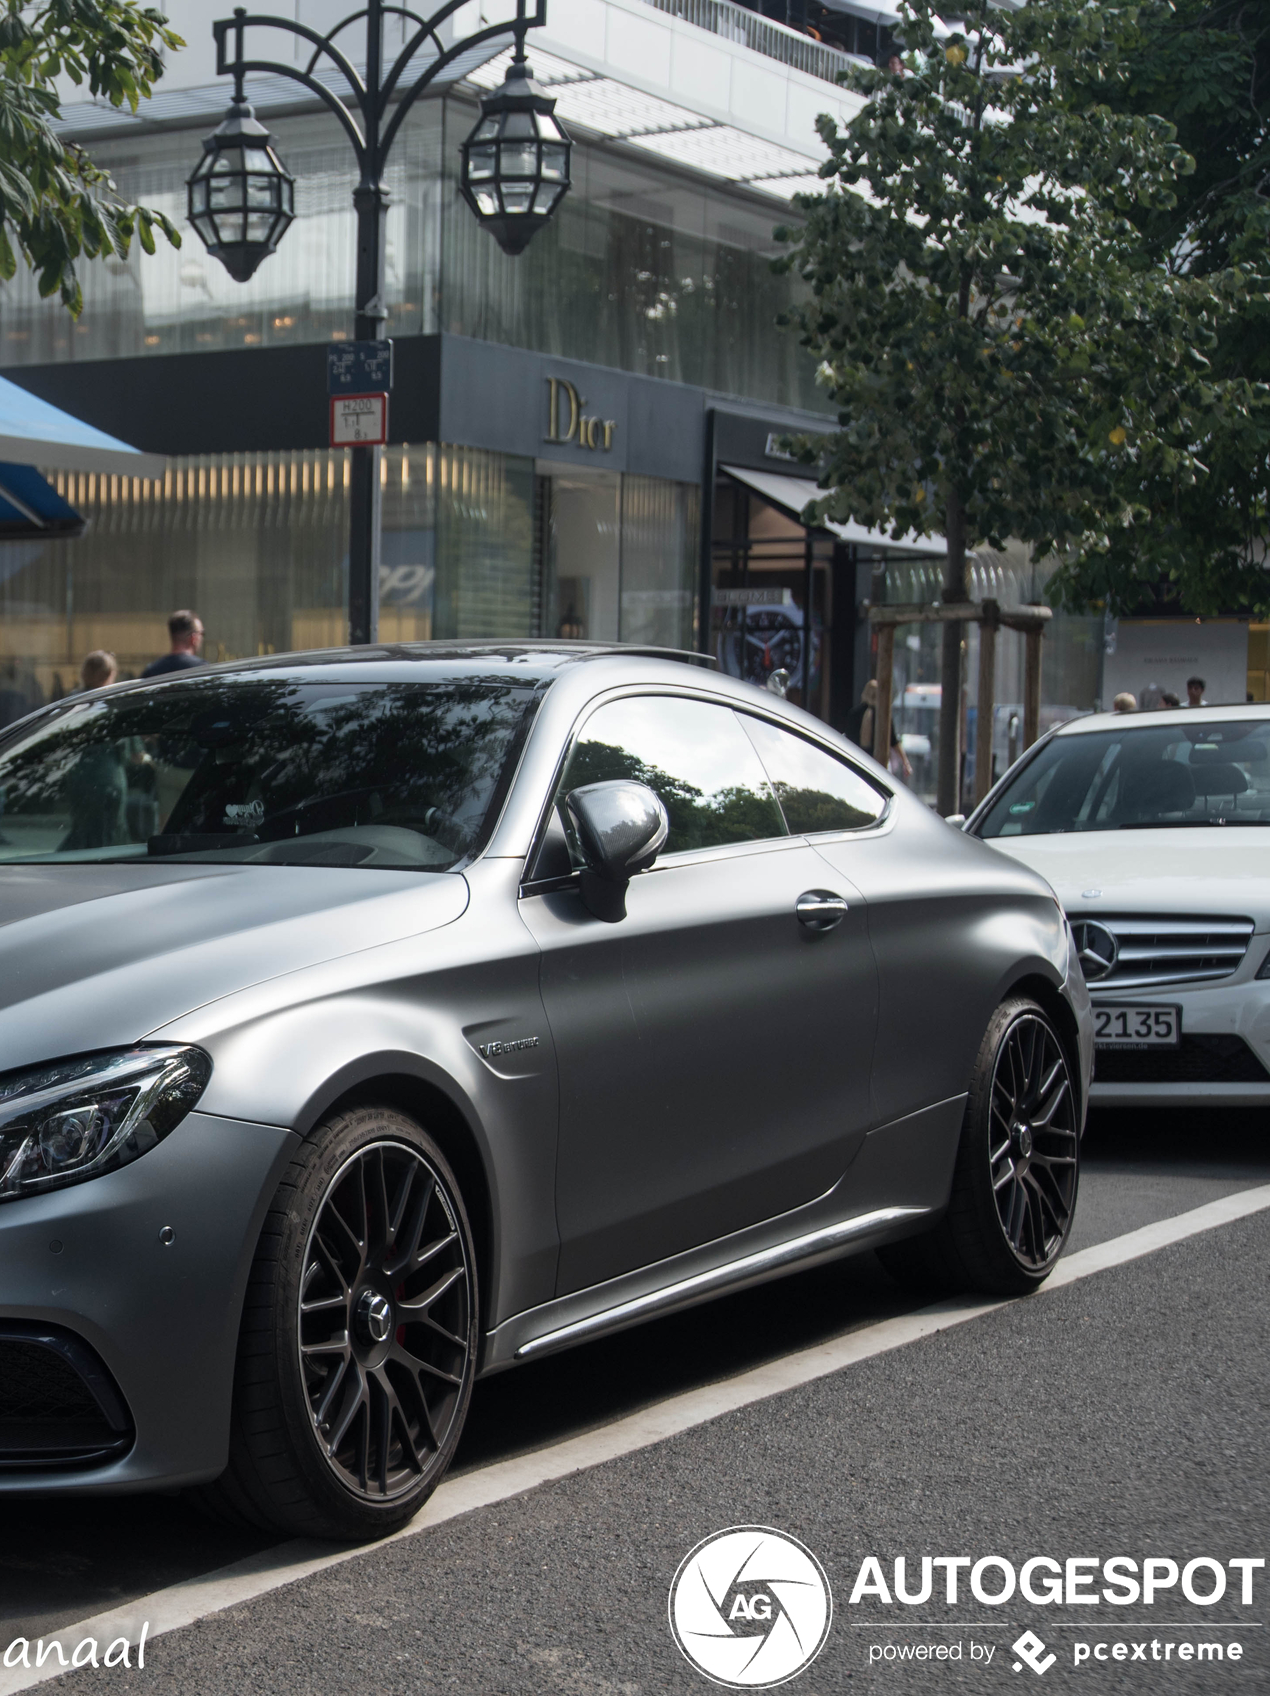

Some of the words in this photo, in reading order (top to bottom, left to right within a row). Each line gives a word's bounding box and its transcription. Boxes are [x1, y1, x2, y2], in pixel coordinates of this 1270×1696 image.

[342, 399, 372, 412] H200
[543, 377, 618, 453] Dior
[1095, 1011, 1173, 1039] 2135
[478, 1040, 502, 1059] V8
